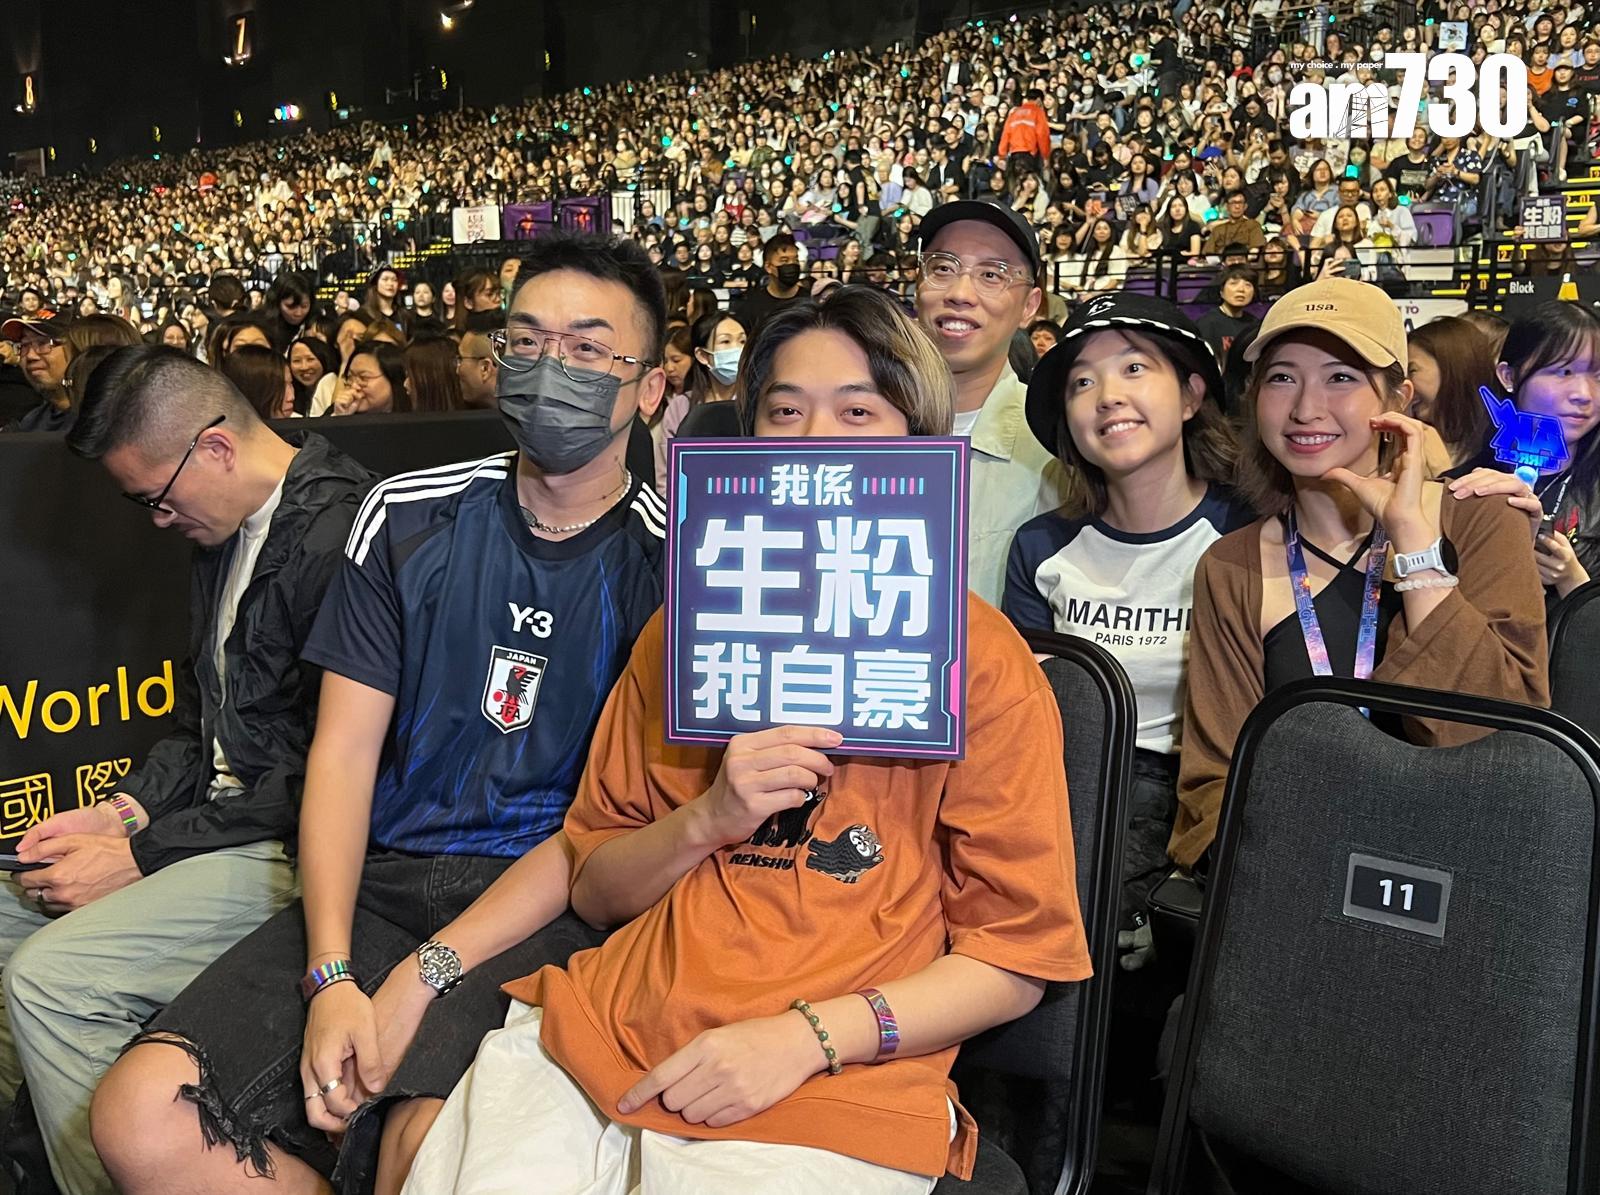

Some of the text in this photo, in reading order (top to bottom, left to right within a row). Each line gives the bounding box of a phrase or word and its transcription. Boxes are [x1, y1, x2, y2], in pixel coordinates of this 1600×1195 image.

[1509, 281, 1535, 294] Block
[771, 464, 853, 506] 我係
[695, 515, 934, 638] 生粉
[508, 602, 554, 639] Y-3
[1095, 632, 1168, 646] PARIS 1972
[506, 652, 537, 665] JAPAN
[0, 660, 175, 740] World
[692, 642, 932, 731] 我自豪
[495, 704, 521, 720] JFA
[1379, 879, 1414, 911] 11
